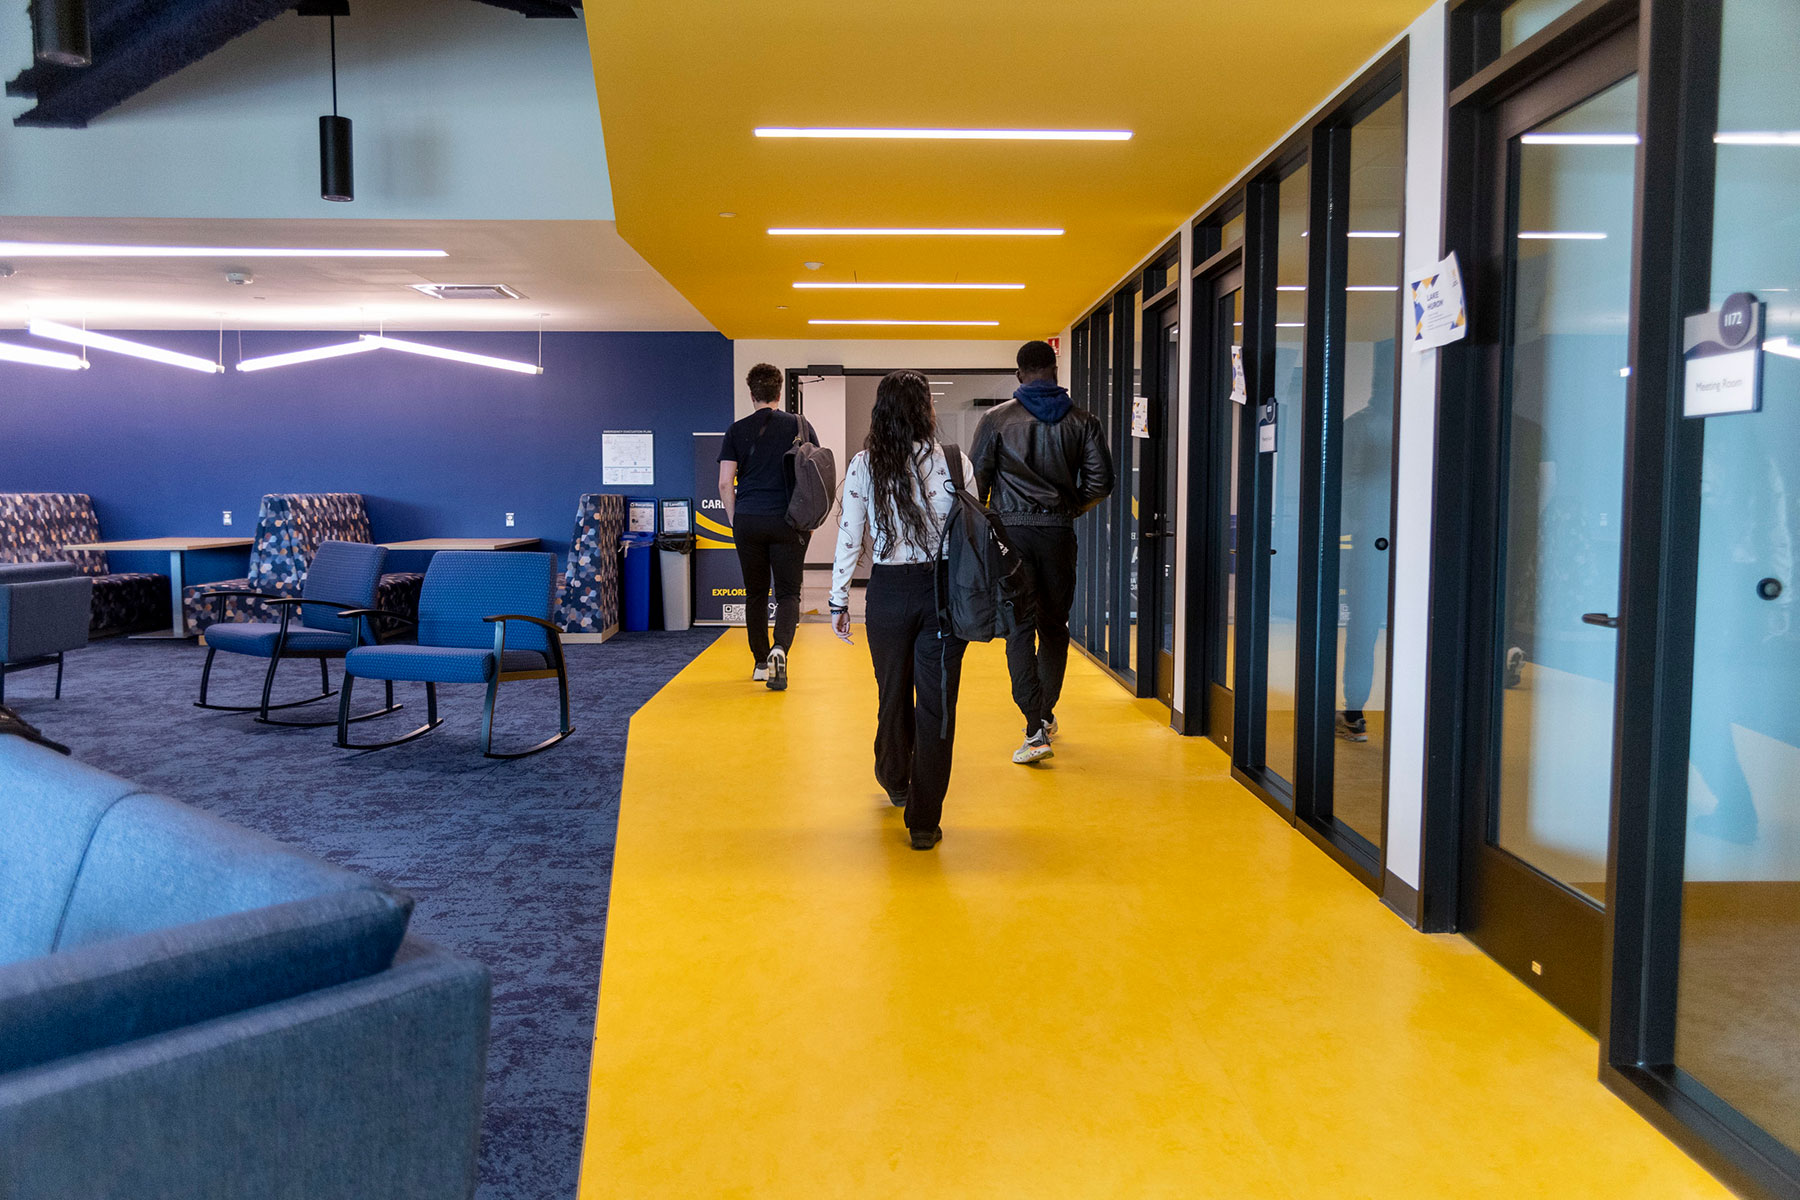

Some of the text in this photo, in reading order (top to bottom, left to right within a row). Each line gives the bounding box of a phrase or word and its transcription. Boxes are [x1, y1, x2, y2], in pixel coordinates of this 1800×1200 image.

[1427, 291, 1440, 301] LAKE
[1724, 312, 1742, 327] 1172
[1696, 378, 1743, 393] Meeting Room
